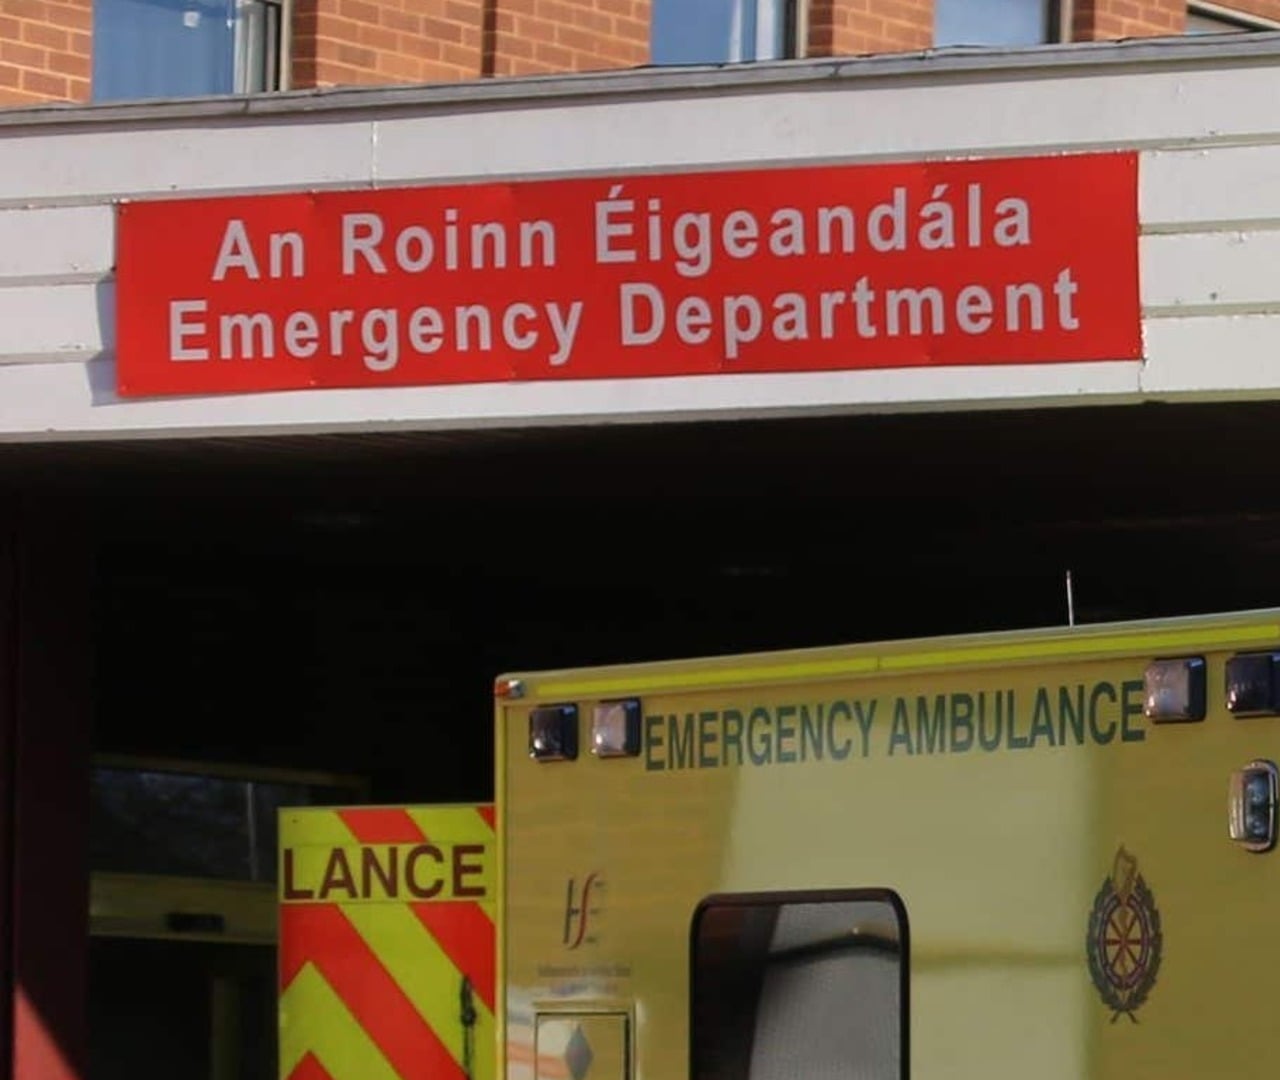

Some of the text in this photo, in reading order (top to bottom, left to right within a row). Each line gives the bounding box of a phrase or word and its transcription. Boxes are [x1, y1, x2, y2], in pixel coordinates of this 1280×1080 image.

[212, 184, 1031, 281] An Roinn Éigeandála
[170, 269, 1080, 372] Emergency Department
[645, 680, 1146, 772] EMERGENCY AMBULANCE
[284, 845, 487, 899] LANCE
